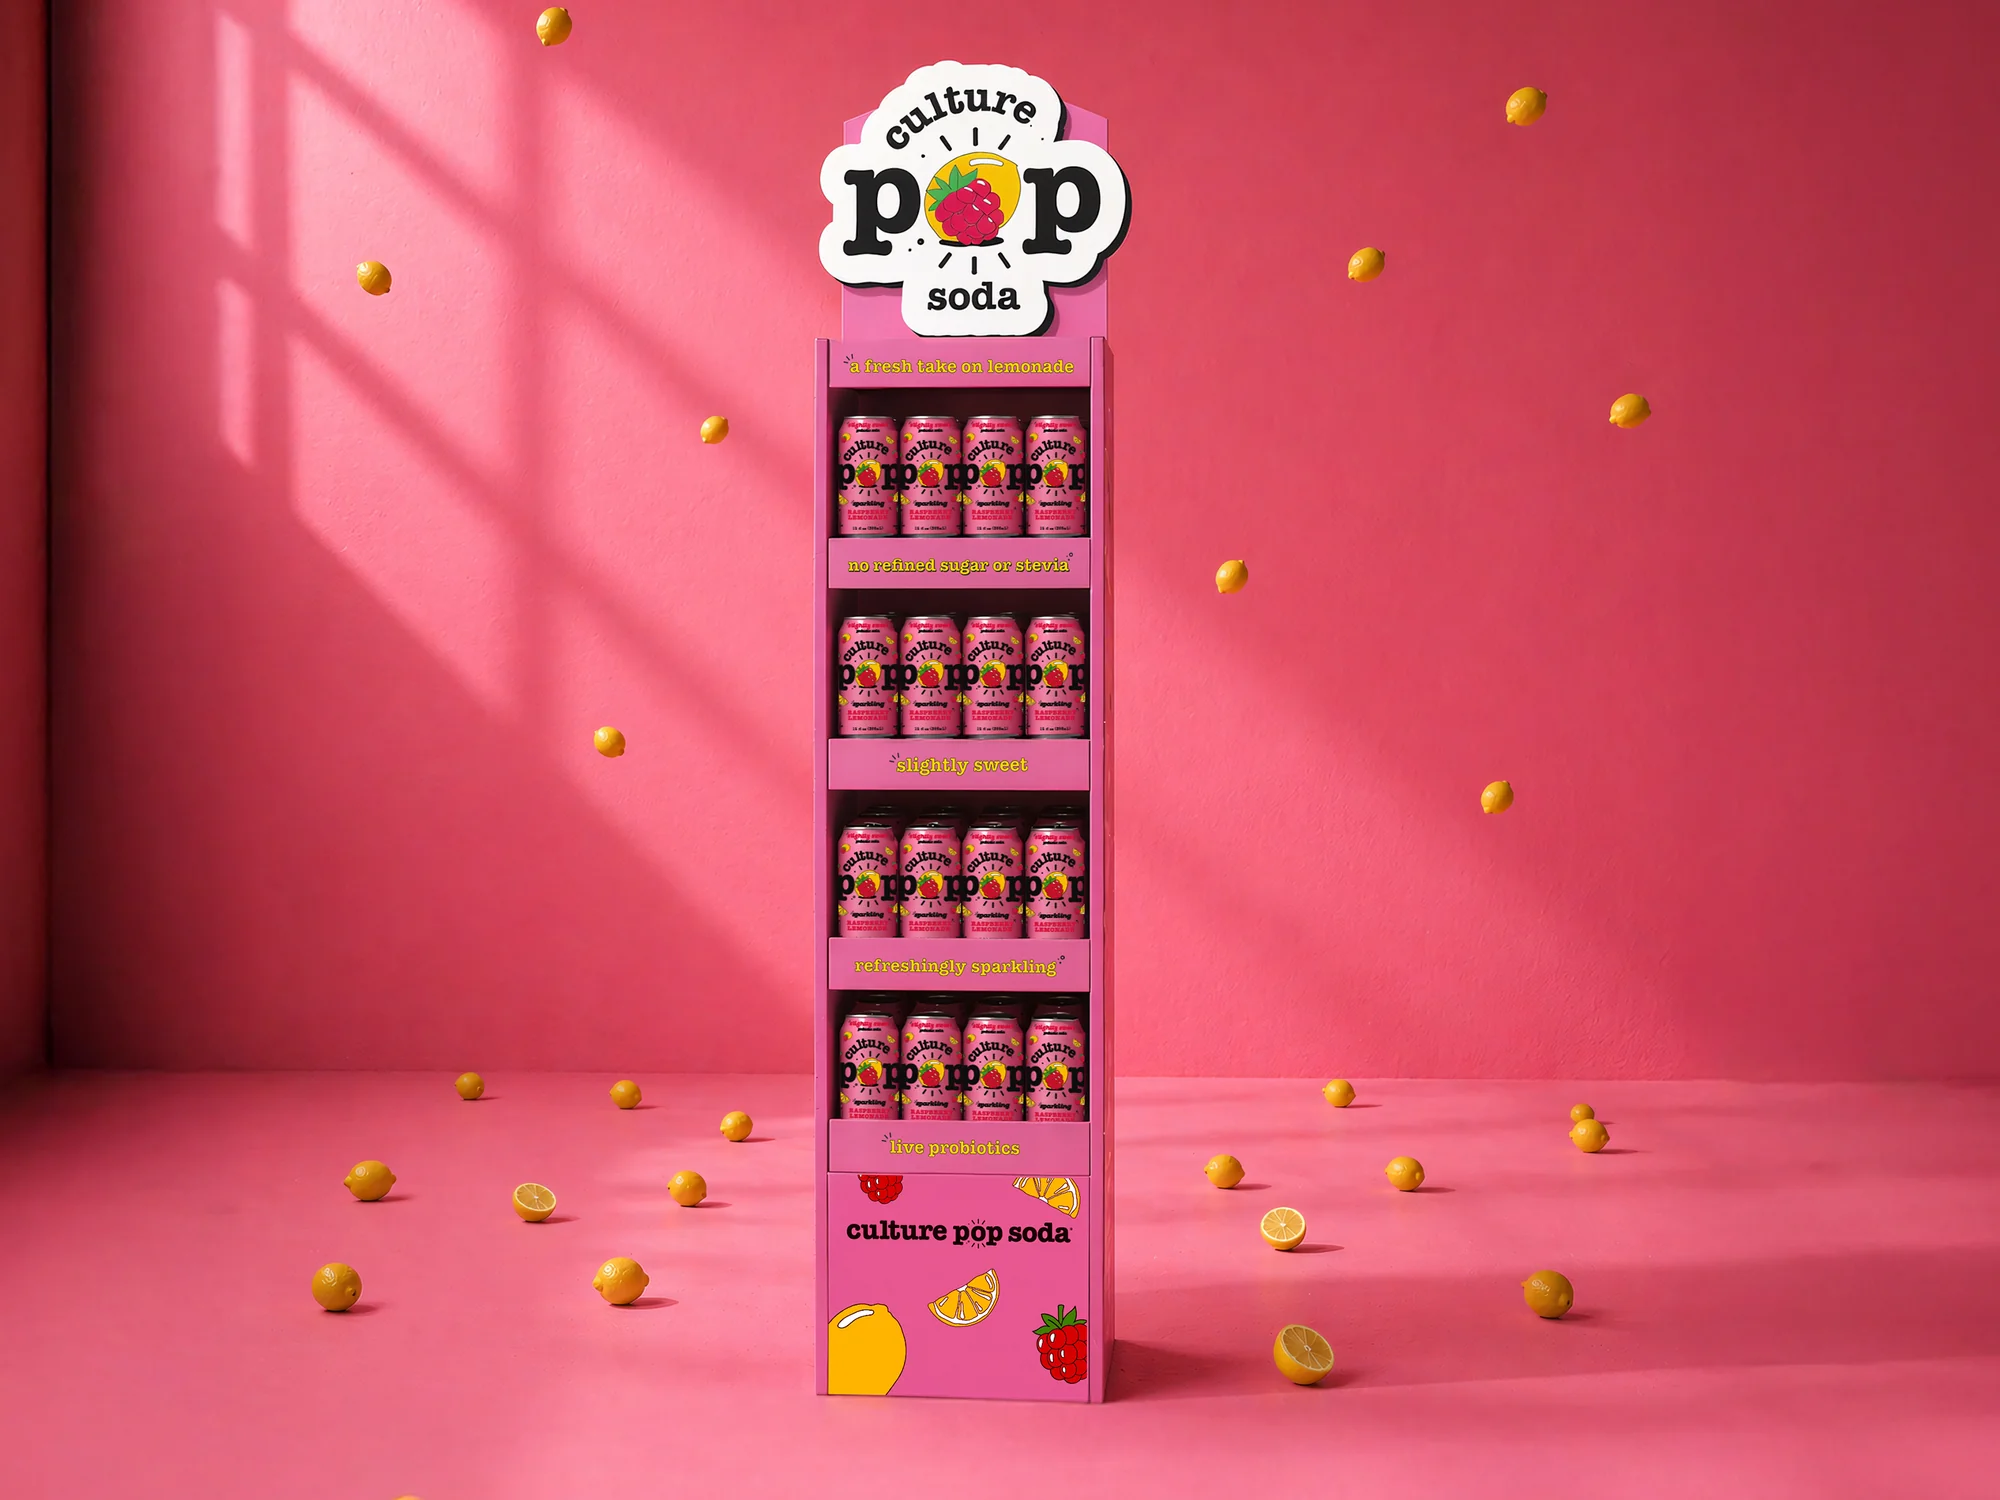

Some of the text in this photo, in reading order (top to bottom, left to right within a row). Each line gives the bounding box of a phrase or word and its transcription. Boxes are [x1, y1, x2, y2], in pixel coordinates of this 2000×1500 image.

[885, 85, 1037, 150] culture
[927, 281, 1021, 311] soda
[850, 359, 1074, 374] a fresh take on lemonade
[844, 440, 889, 461] culture
[905, 440, 952, 461] culture
[967, 440, 1014, 461] culture
[1031, 440, 1076, 461] culture
[848, 558, 1070, 575] no refined sugar or stevia
[844, 640, 889, 661] culture
[905, 640, 952, 661] culture
[967, 640, 1014, 661] culture
[1031, 640, 1076, 661] culture
[896, 757, 1028, 776] slightly sweet
[843, 851, 888, 872] culture
[905, 851, 951, 872] culture
[967, 852, 1014, 873] culture
[1031, 852, 1076, 873] culture
[855, 958, 1057, 977] refreshingly sparkling
[845, 1038, 890, 1059] culture
[906, 1040, 953, 1061] culture
[968, 1041, 1015, 1062] culture
[1031, 1043, 1076, 1063] culture
[890, 1140, 1021, 1157] live probiotics
[846, 1220, 1071, 1246] culture pop soda
